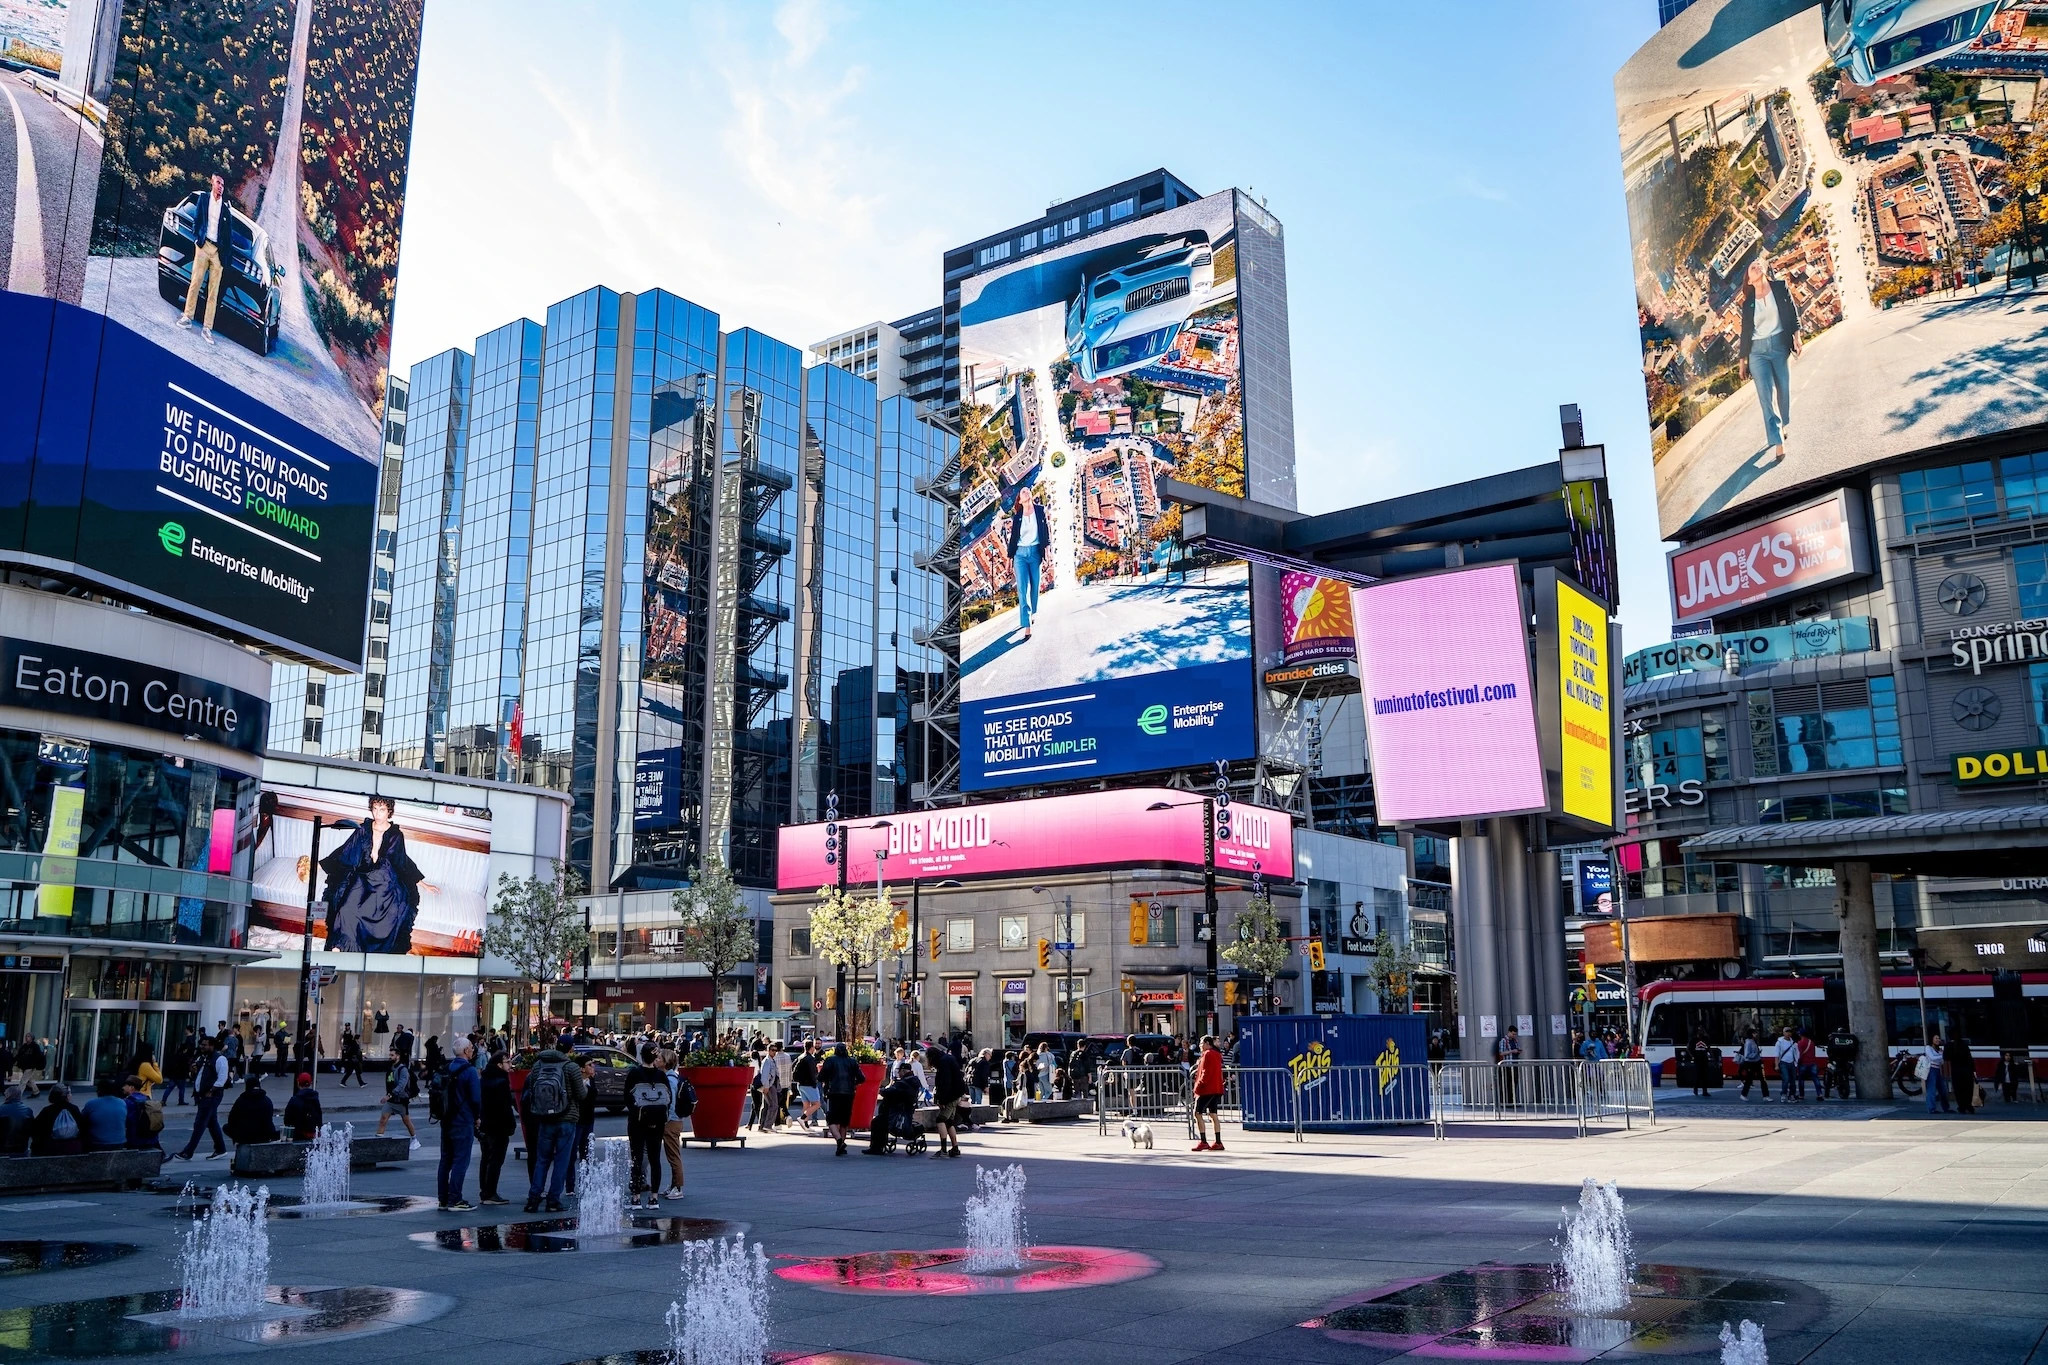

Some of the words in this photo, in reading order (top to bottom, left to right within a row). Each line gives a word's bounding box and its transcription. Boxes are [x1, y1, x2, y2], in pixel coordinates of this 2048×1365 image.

[163, 427, 188, 456] TO
[192, 441, 240, 479] DRIVE
[245, 467, 287, 503] YOUR
[166, 402, 192, 434] WE
[198, 418, 236, 453] FIND
[240, 441, 276, 472] NEW
[278, 460, 328, 500] ROADS
[160, 450, 242, 505] BUSINESS
[245, 496, 320, 540] FORWARD
[1796, 518, 1832, 540] PARTY
[191, 538, 258, 580] Enterprise
[1797, 536, 1825, 554] THIS
[1679, 532, 1795, 608] JACK'S
[1740, 548, 1750, 589] ASTORS
[1800, 552, 1826, 570] WAY
[1796, 629, 1816, 639] Hard
[1817, 626, 1837, 638] Rock
[1950, 624, 2006, 640] LOUNGE
[1305, 646, 1324, 655] HARD
[1652, 636, 1768, 668] TORONTO
[1266, 663, 1344, 683] brandedcities
[15, 654, 130, 706] Eaton
[143, 680, 238, 732] Centre
[1373, 682, 1517, 716] luminatofestival.com
[1173, 700, 1224, 717] Enterprise
[984, 721, 1002, 736] WE
[1005, 716, 1028, 733] SEE
[1030, 712, 1072, 729] ROADS
[984, 734, 1016, 750] THAT
[1018, 728, 1053, 744] MAKE
[984, 744, 1041, 764] MOBILITY
[1044, 737, 1097, 757] SIMPLER
[1957, 750, 2048, 780] DOLL
[1216, 759, 1231, 840] Yonge
[1624, 779, 1704, 814] ERS
[888, 819, 922, 856] BIG
[928, 812, 991, 853] MOOD
[1231, 810, 1270, 850] MOOD
[652, 929, 678, 946] MUJI
[1346, 940, 1360, 952] Foot
[1975, 942, 2005, 955] ENOR
[606, 986, 622, 996] MUJI
[1288, 1043, 1332, 1092] Takis
[1376, 1041, 1400, 1096] Takis
